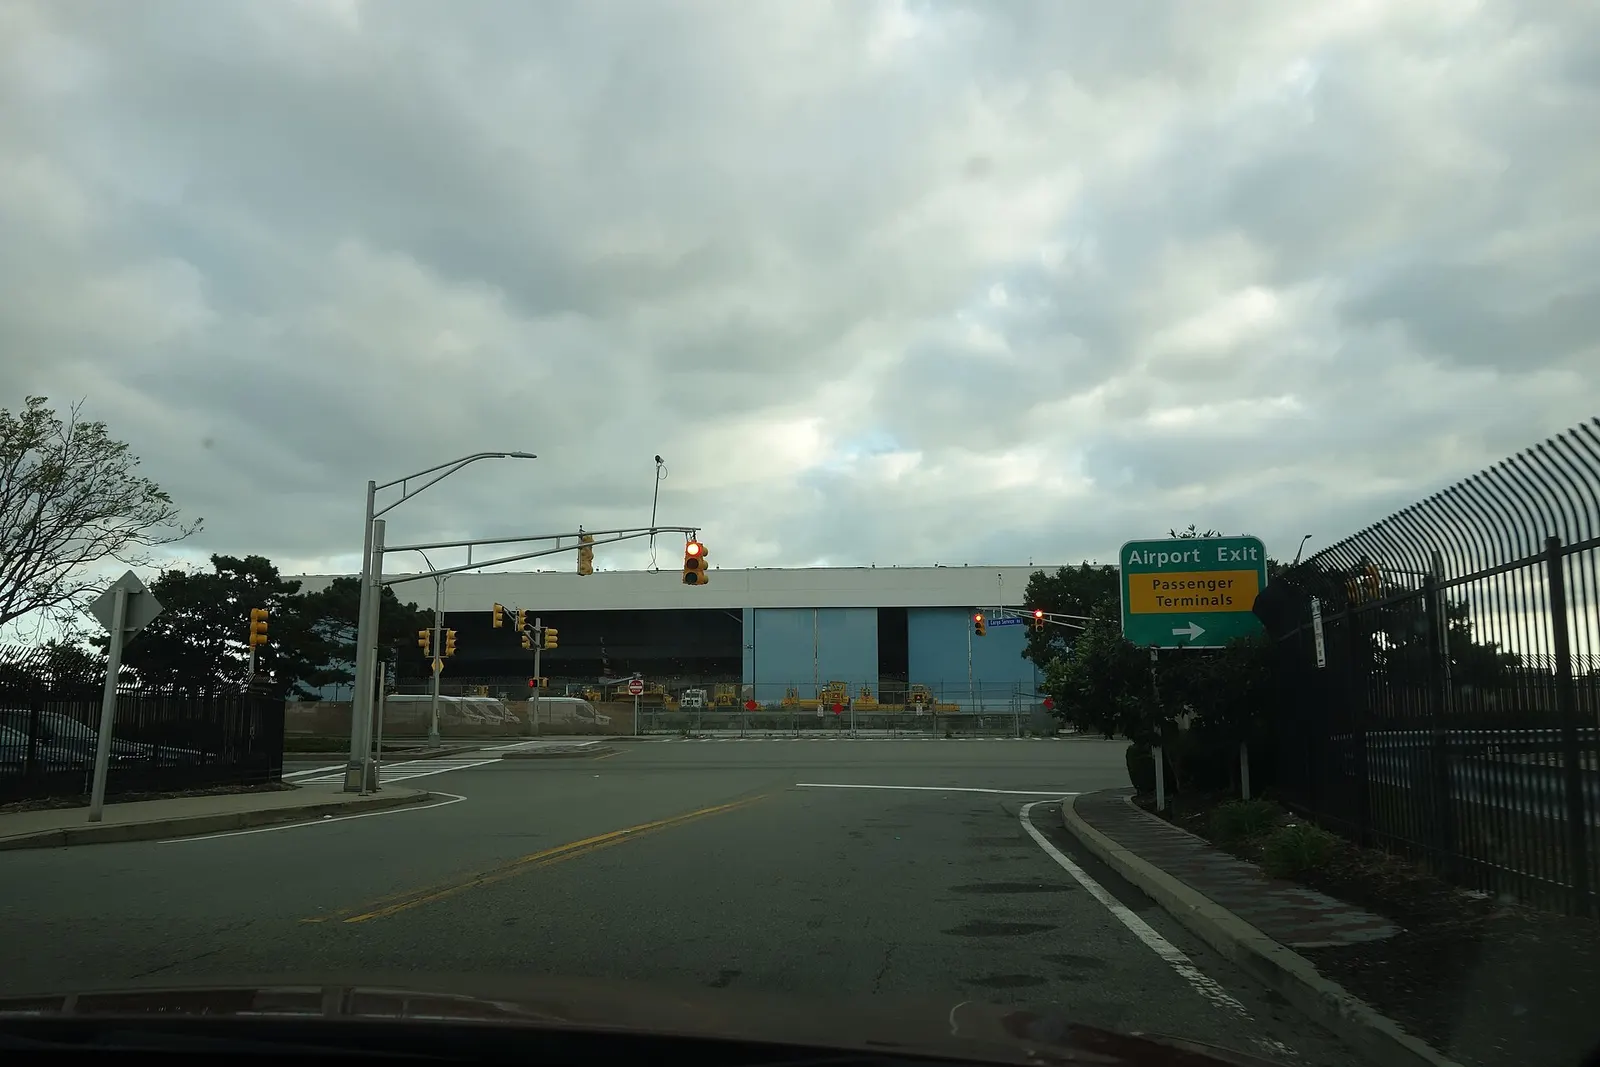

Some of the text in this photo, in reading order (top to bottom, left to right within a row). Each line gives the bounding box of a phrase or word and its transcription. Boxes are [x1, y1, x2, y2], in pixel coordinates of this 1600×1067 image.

[1128, 547, 1257, 567] Airport Exit
[1153, 579, 1233, 591] Passenger
[1156, 594, 1233, 607] Terminals
